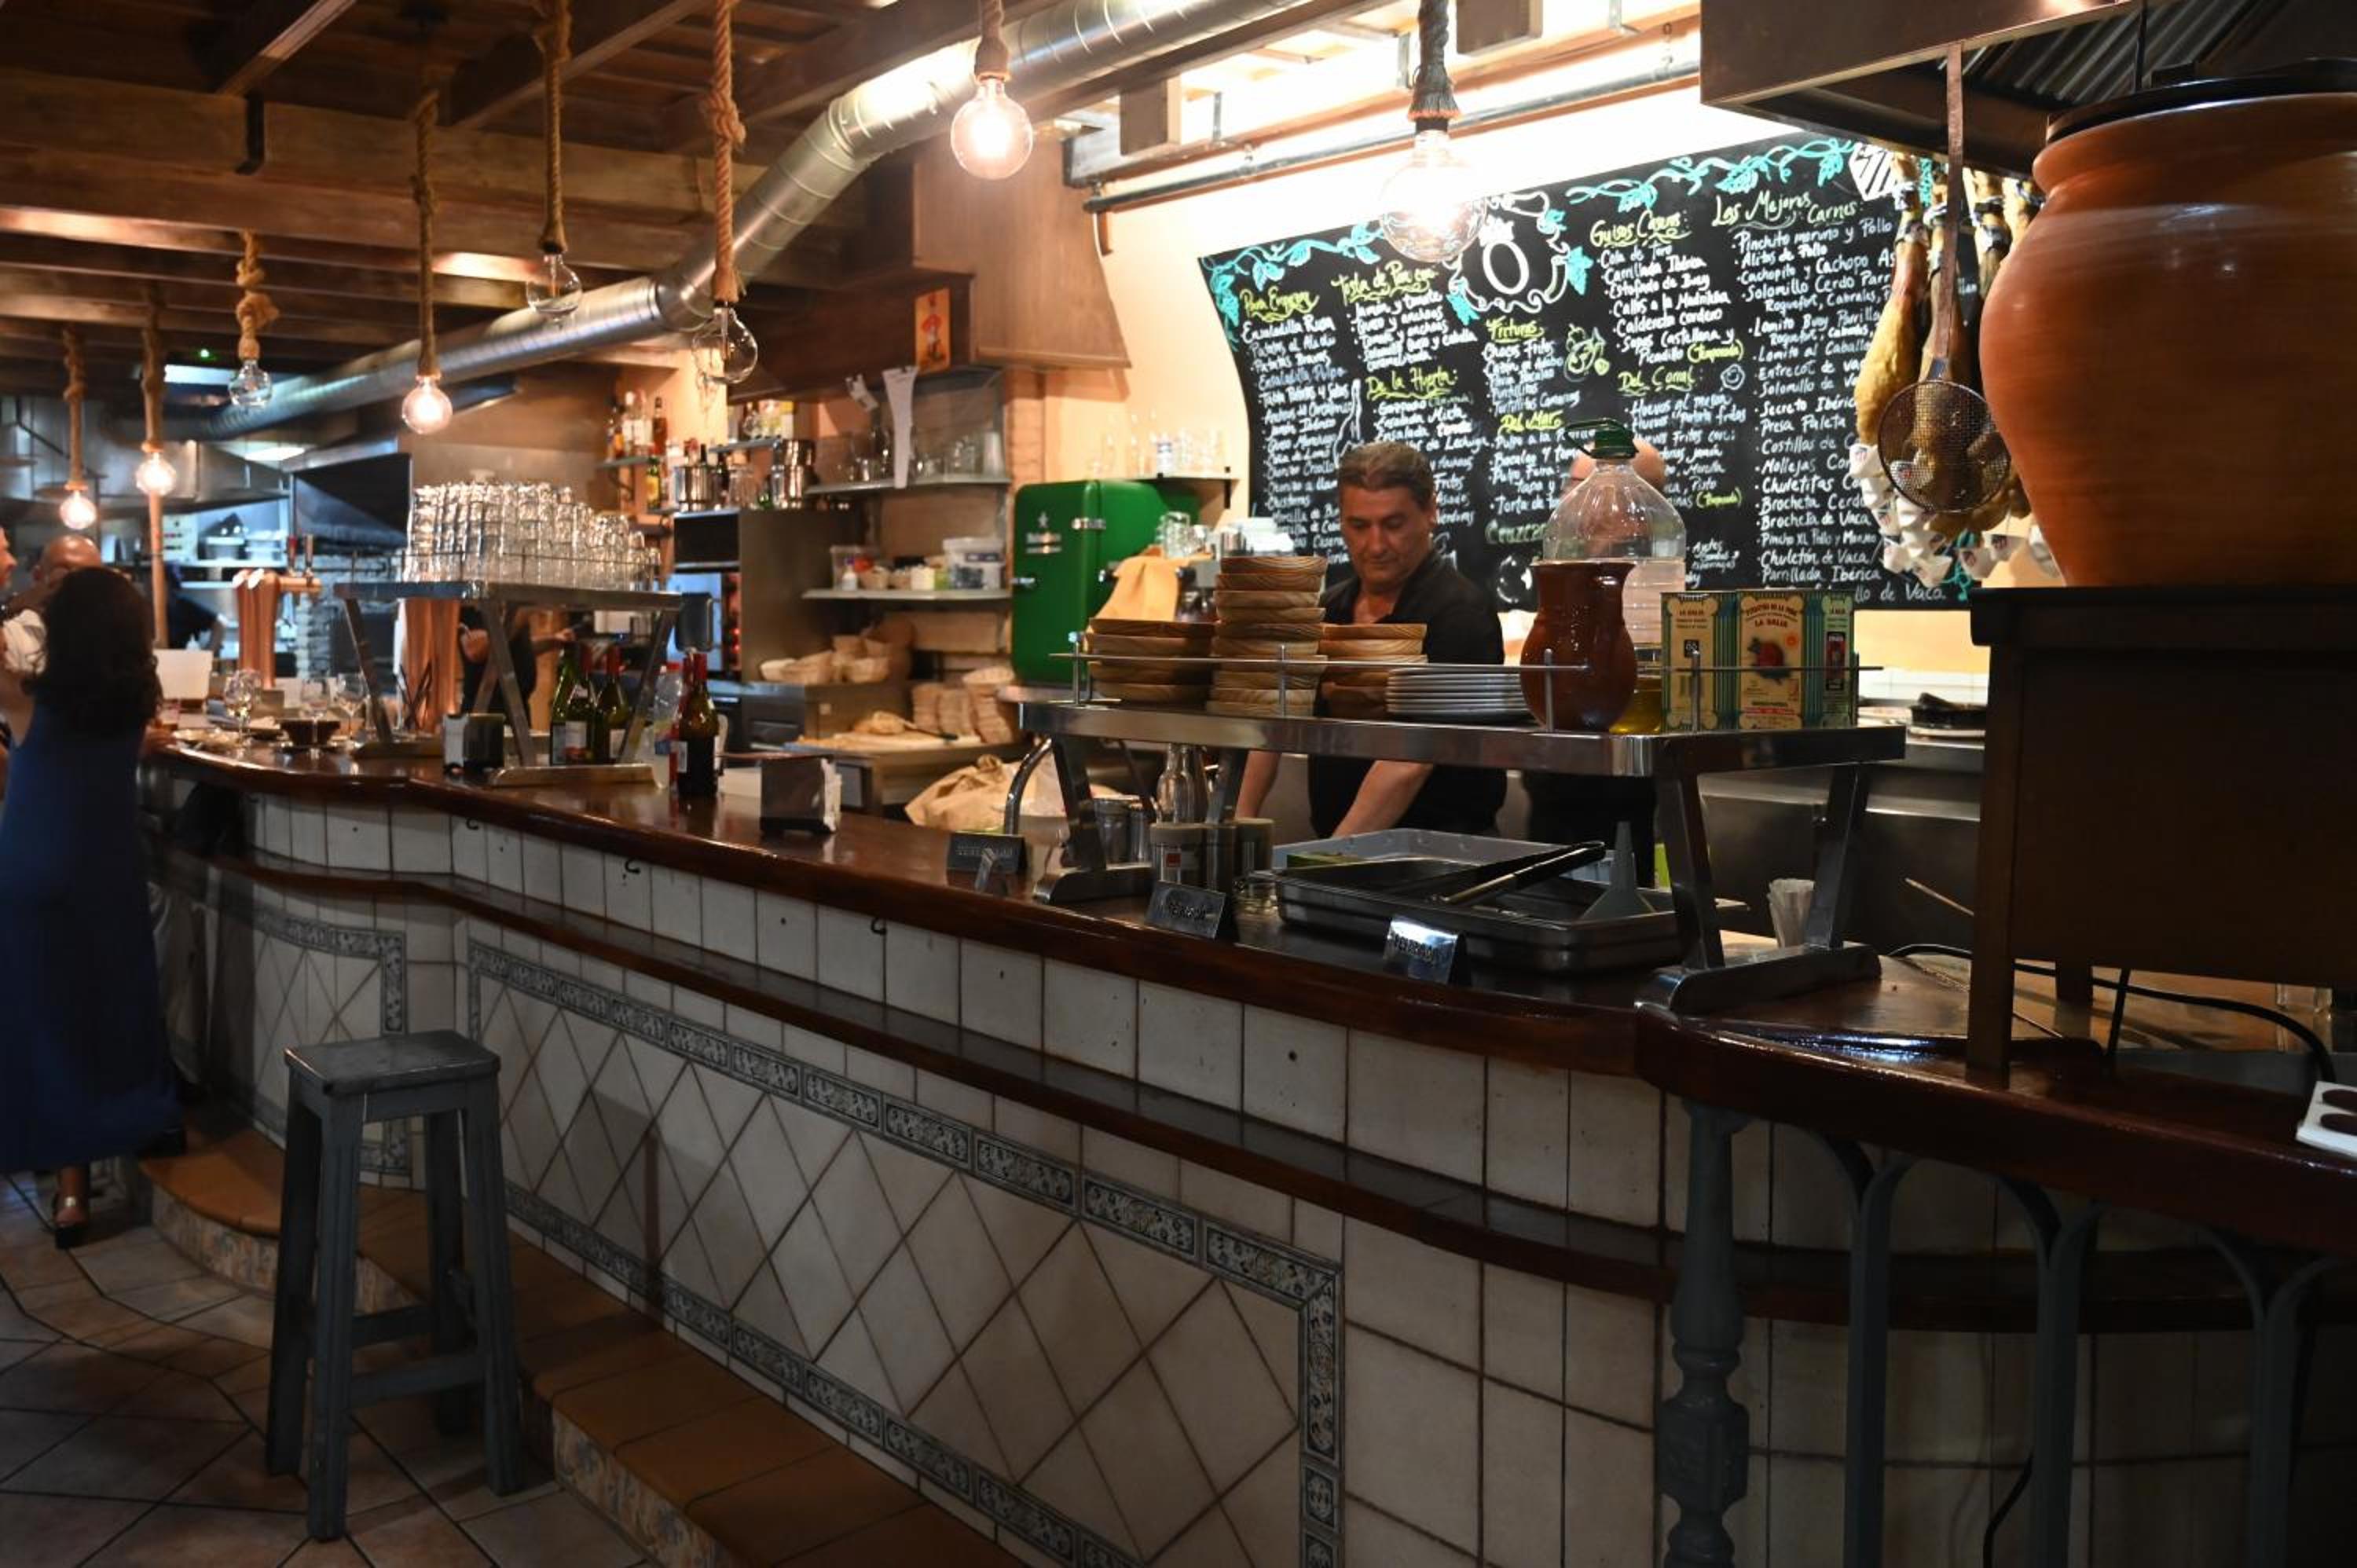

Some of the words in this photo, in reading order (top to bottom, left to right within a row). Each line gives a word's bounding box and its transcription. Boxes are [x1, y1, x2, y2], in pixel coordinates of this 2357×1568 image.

[1858, 217, 1893, 239] Pollo
[1814, 275, 1856, 294] Cerdo
[1800, 413, 1847, 434] Paleta
